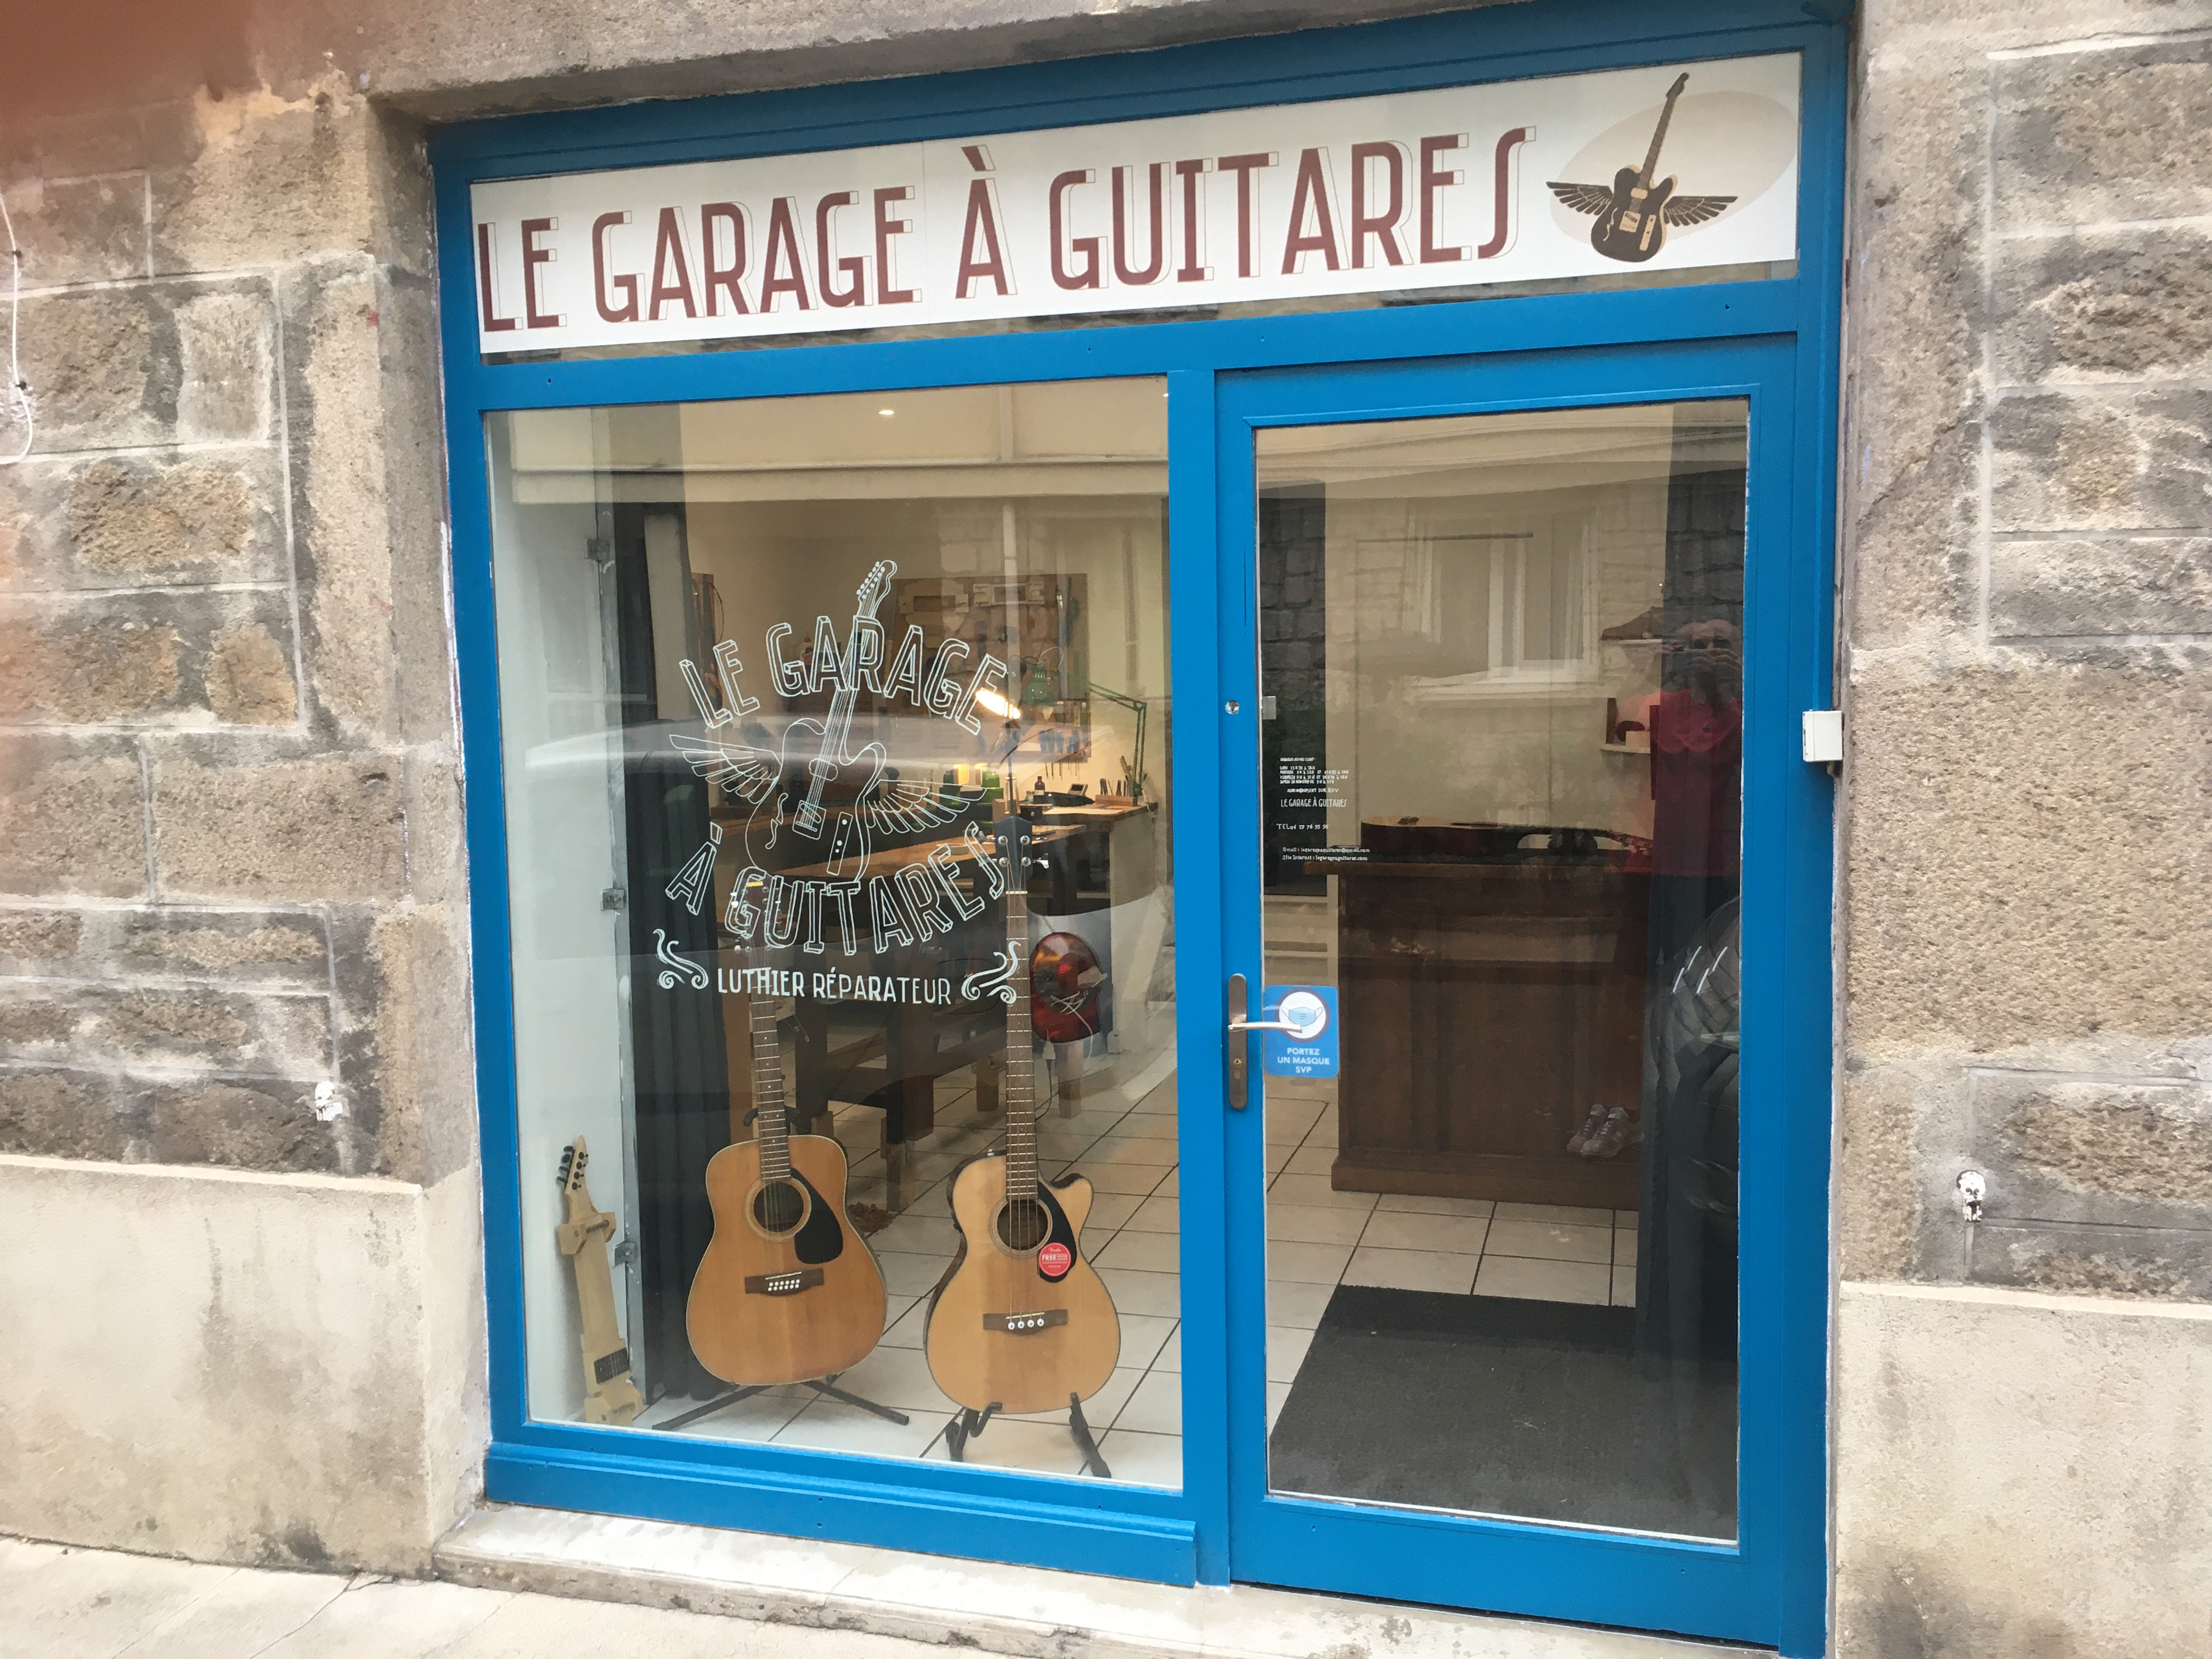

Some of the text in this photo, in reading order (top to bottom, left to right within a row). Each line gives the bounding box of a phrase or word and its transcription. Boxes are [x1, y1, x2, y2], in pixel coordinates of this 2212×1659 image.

[477, 126, 1537, 333] LE GARAGE À GUITARES
[679, 616, 1007, 735] LE GARAGE
[1280, 796, 1347, 808] LE GARAGE À GUITARES
[664, 821, 1005, 956] À GUITARES
[717, 967, 951, 1005] LUTHIER RÉPARATEUR
[1293, 1057, 1330, 1065] MASQUE
